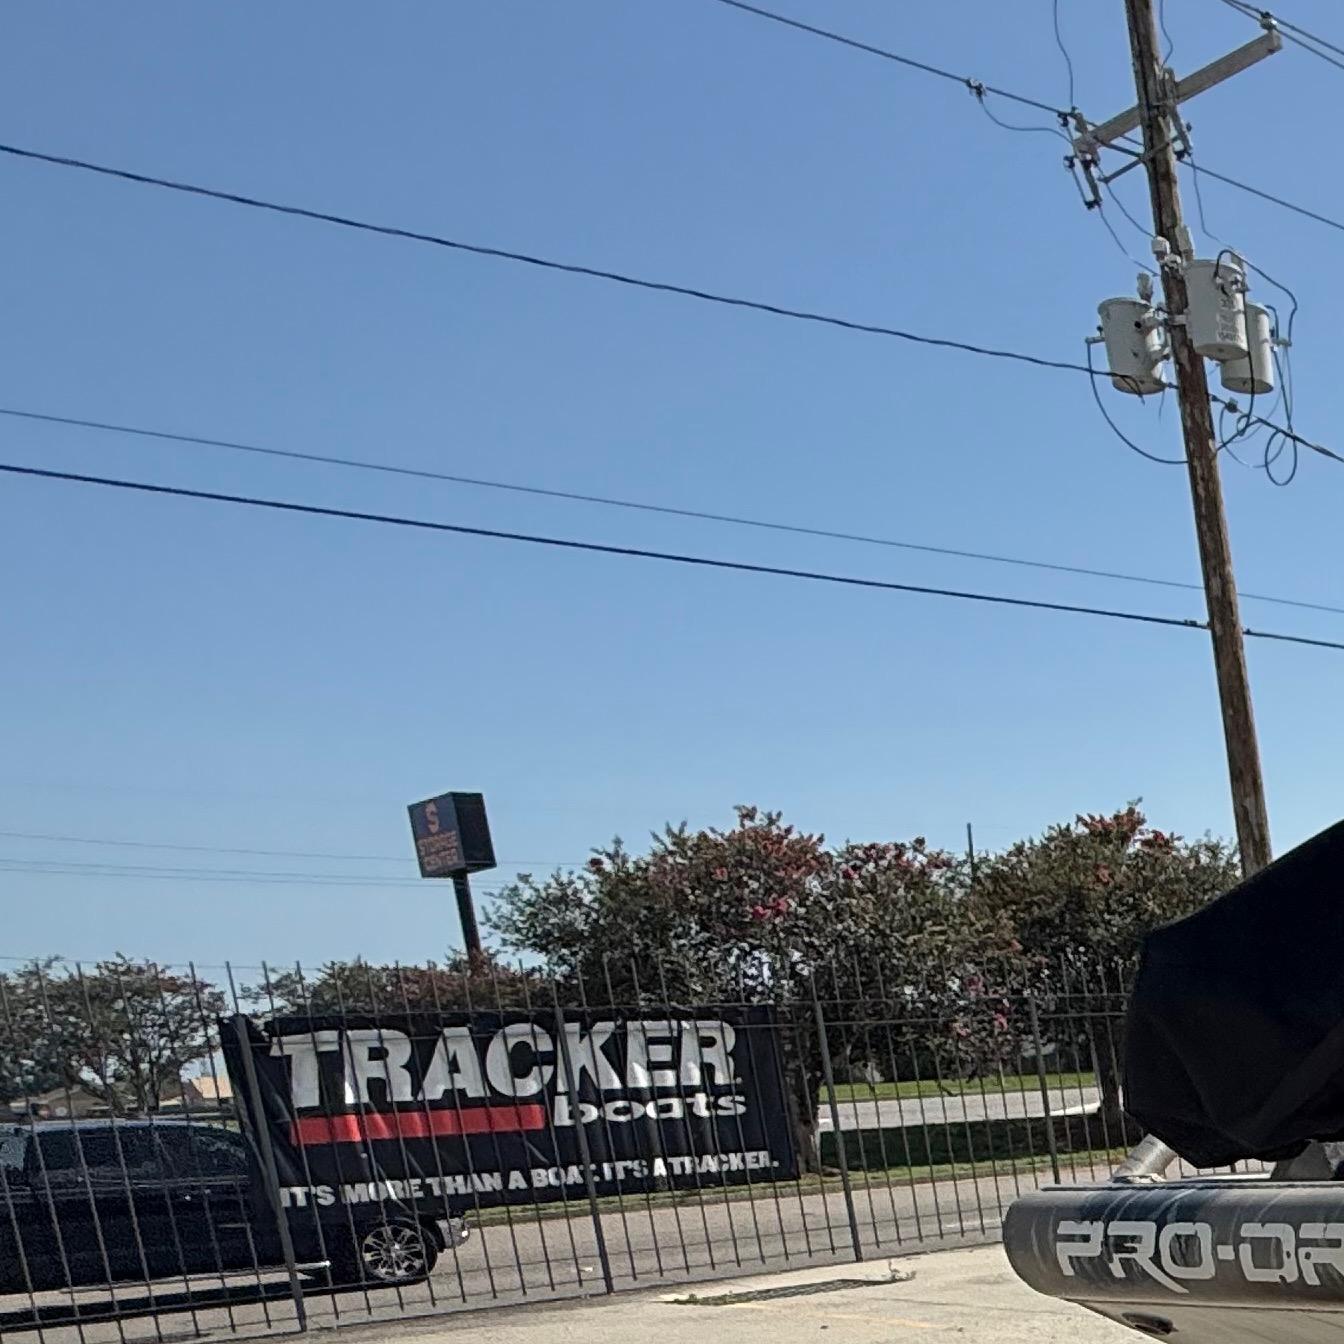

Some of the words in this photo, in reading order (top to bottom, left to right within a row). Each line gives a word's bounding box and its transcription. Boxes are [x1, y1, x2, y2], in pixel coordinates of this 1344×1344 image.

[269, 1020, 737, 1108] TRACKER
[553, 1093, 747, 1126] boats
[279, 1184, 335, 1207] IT'S
[343, 1178, 423, 1203] MORE
[423, 1172, 502, 1197] THAN
[508, 1170, 527, 1190] A
[603, 1159, 649, 1180] IT'S
[653, 1157, 668, 1177] A
